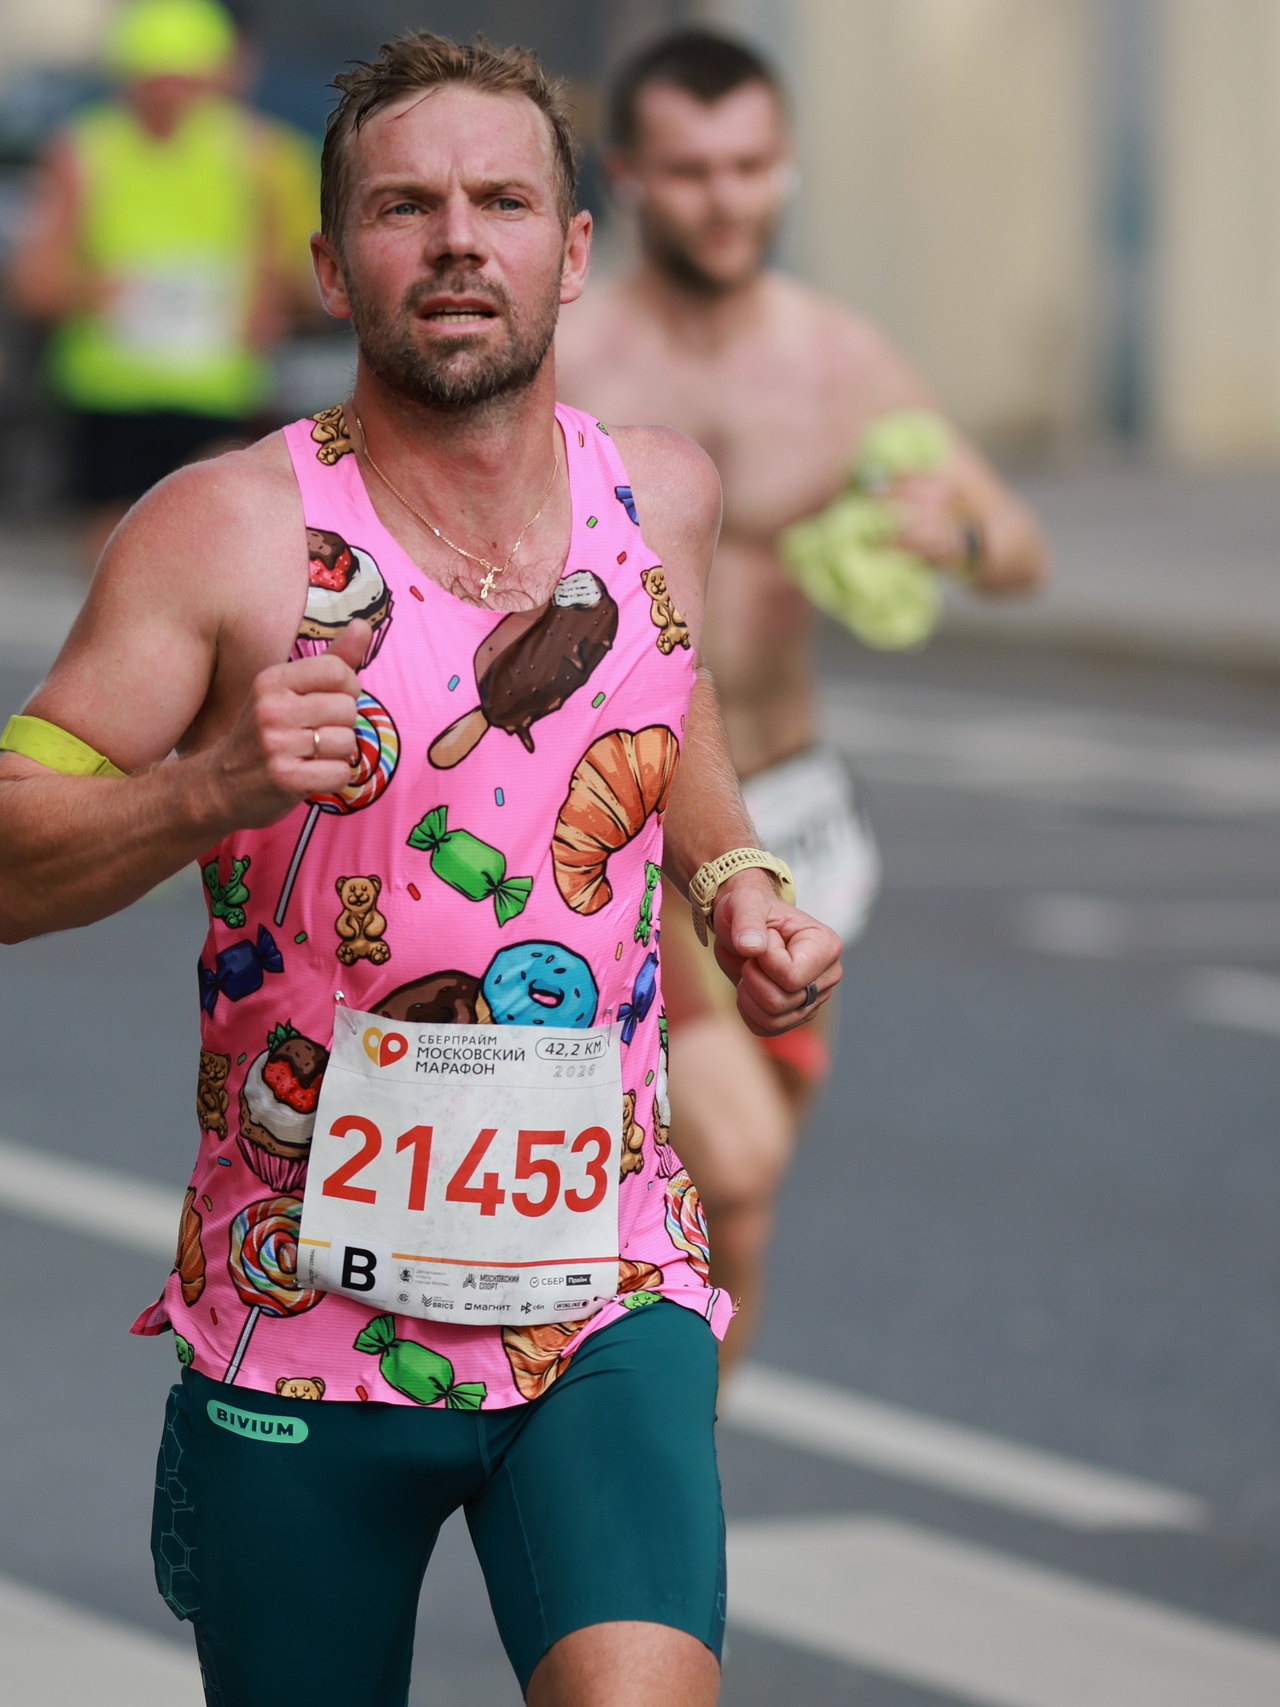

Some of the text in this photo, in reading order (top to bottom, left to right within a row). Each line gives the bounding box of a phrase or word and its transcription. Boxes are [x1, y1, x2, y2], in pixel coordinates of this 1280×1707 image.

[418, 1034, 497, 1045] СБЕРПРАЙМ
[416, 1047, 525, 1062] МОСКОВСКИЙ
[545, 1040, 602, 1057] 42,2 КМ
[415, 1061, 495, 1075] МАРАФОН
[321, 1114, 612, 1217] 21453
[341, 1245, 377, 1292] B
[478, 1282, 499, 1291] СПОРТ
[541, 1277, 565, 1286] СБЕР
[432, 1302, 454, 1310] BRICS
[556, 1301, 582, 1309] WINLINE
[216, 1407, 294, 1437] BIVIUM
